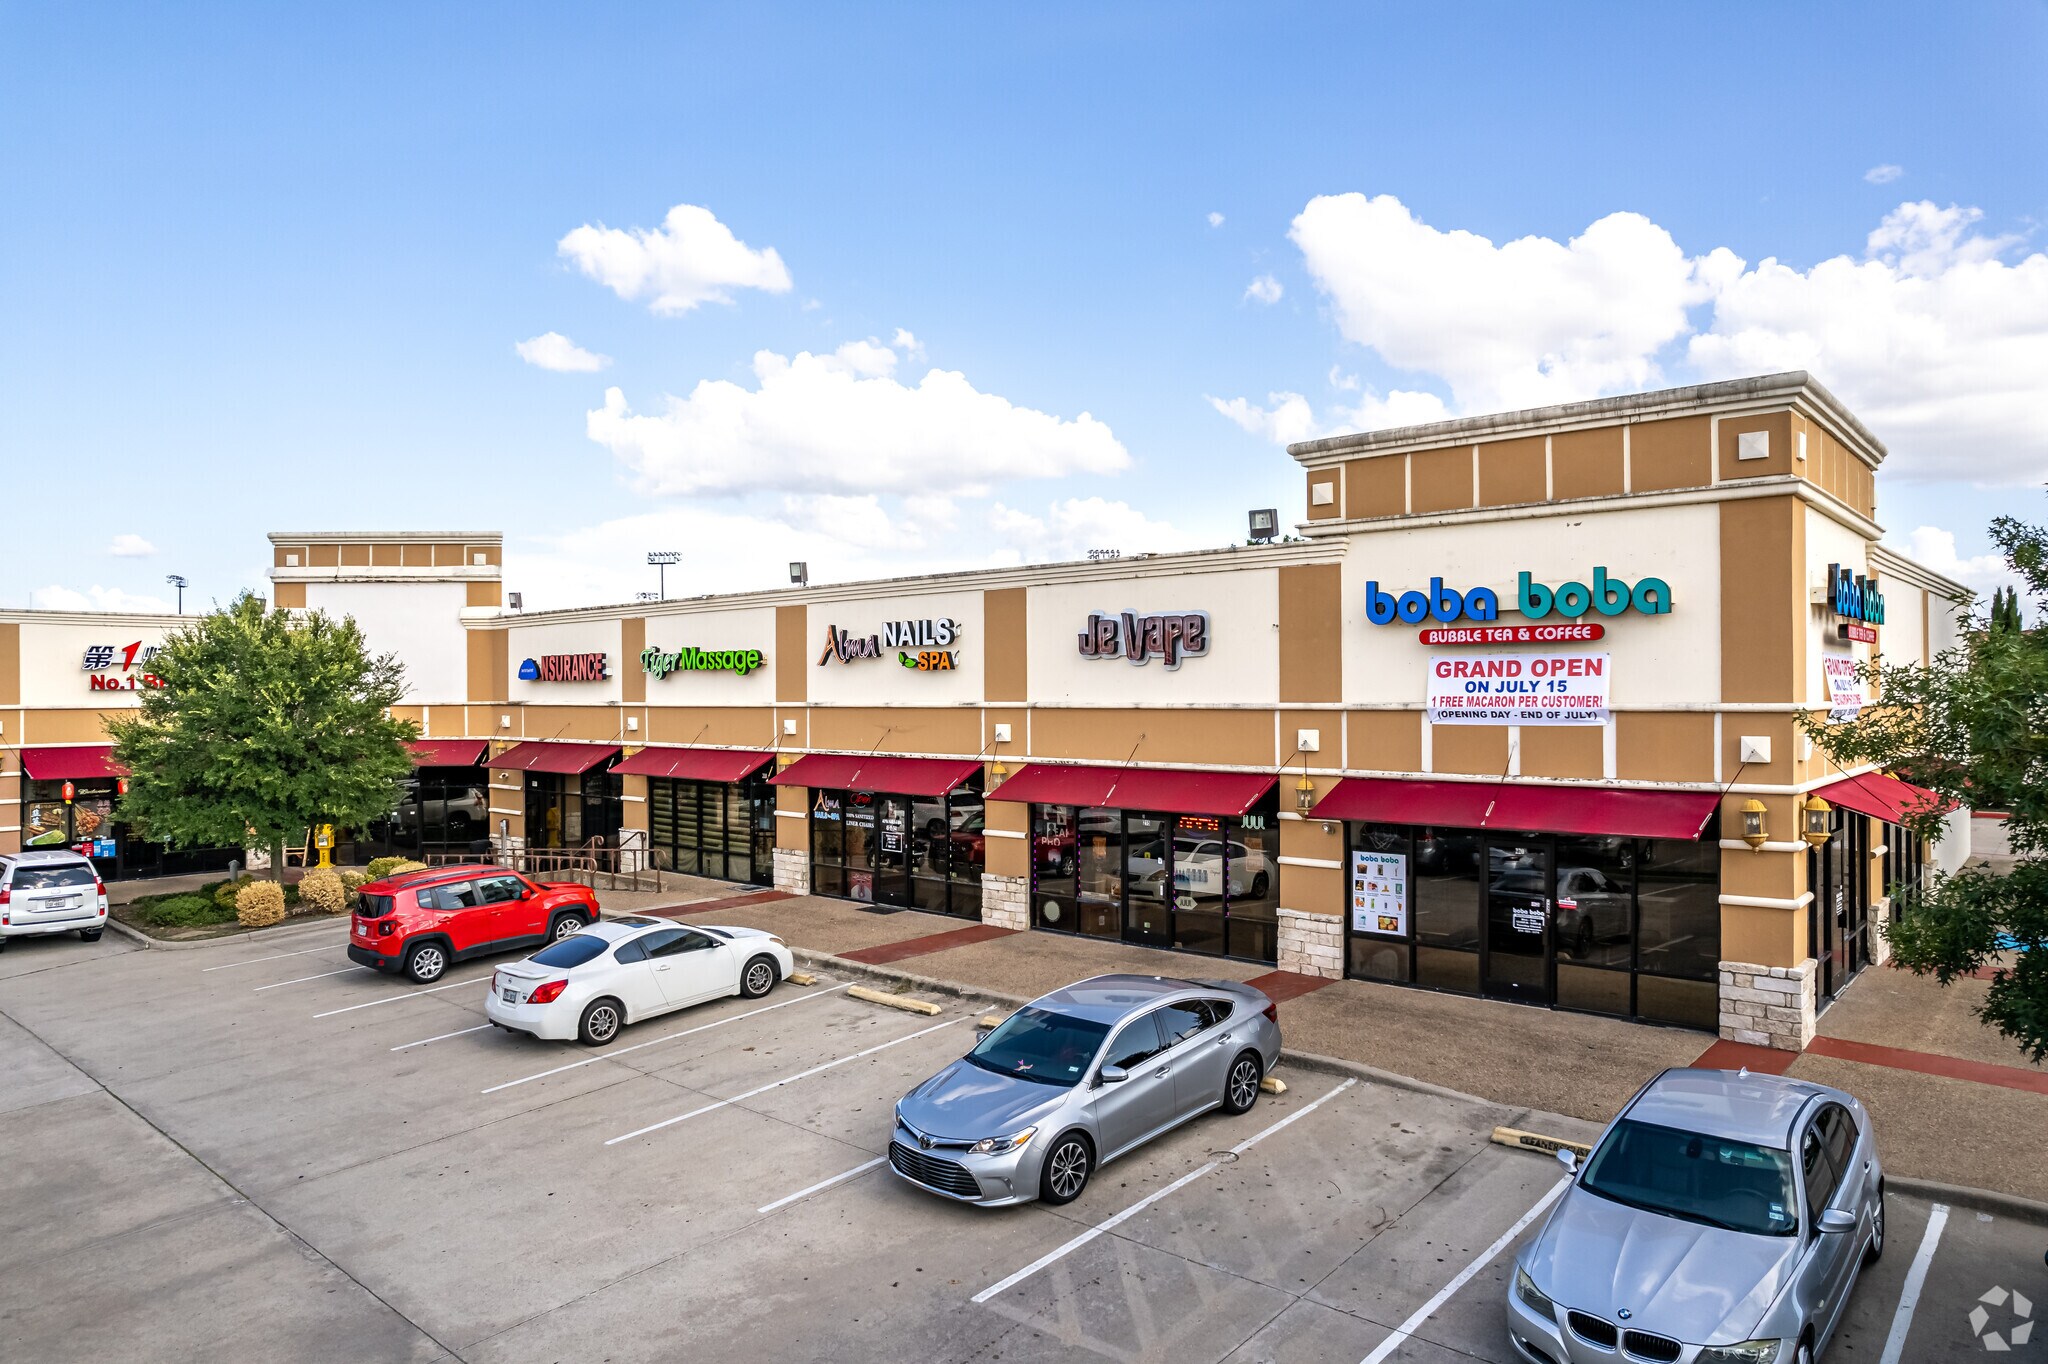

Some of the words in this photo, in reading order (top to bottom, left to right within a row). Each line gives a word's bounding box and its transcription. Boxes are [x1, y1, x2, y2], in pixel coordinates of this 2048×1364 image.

[1366, 581, 1498, 625] boba
[1518, 566, 1673, 619] boba
[882, 618, 952, 647] NAILS
[1078, 614, 1119, 655] Je
[1121, 612, 1205, 665] Vape
[1429, 629, 1482, 643] BUBBLE
[1486, 628, 1513, 641] TEA
[1517, 627, 1530, 640] &
[1534, 626, 1591, 640] COFFEE
[81, 640, 162, 671] 第1
[817, 625, 879, 666] Alma
[640, 646, 680, 680] Tiger
[681, 646, 760, 676] Massage
[917, 651, 952, 671] SPA
[1435, 661, 1522, 679] GRAND
[1530, 658, 1603, 677] OPEN
[90, 675, 135, 690] No.1
[1464, 681, 1490, 693] ON
[1494, 681, 1540, 693] JULY
[1546, 680, 1568, 692] 15
[1431, 697, 1437, 708] 1
[1439, 696, 1464, 708] FREE
[1466, 696, 1515, 708] MACARON
[1518, 696, 1538, 708] PER
[1541, 695, 1603, 708] CUSTOMER!
[1437, 711, 1488, 720] (OPENING
[1490, 711, 1511, 719] DAY
[1521, 711, 1543, 719] END
[1546, 711, 1561, 719] OF
[1563, 711, 1598, 720] JULY)
[1360, 854, 1378, 862] boba
[1380, 855, 1399, 864] boba
